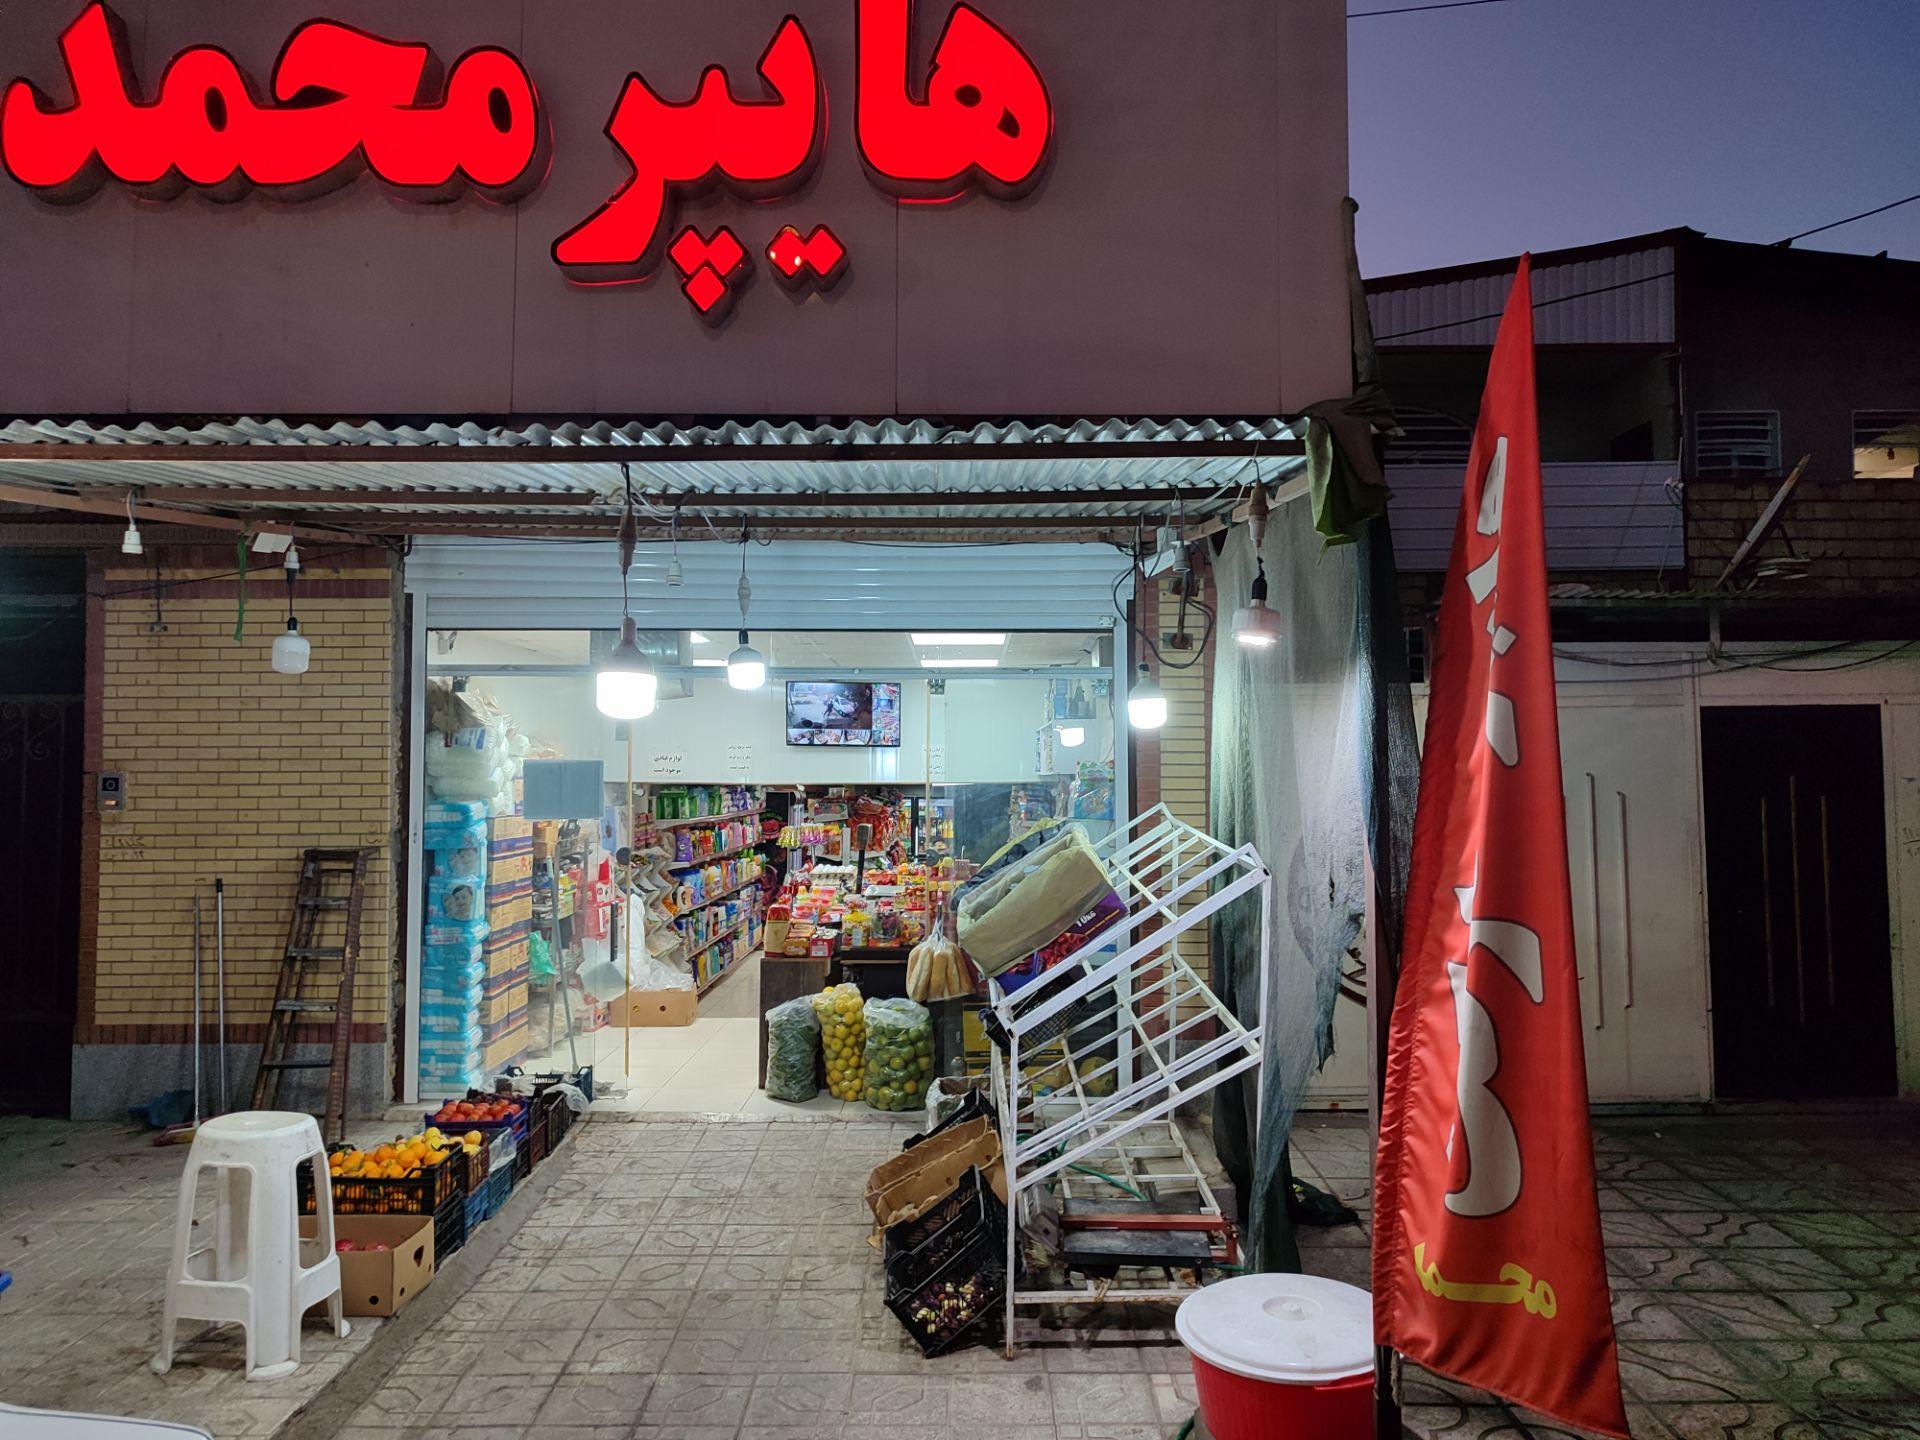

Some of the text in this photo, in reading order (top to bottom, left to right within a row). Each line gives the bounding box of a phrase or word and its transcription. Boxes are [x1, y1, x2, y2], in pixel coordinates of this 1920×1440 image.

[2, 0, 1053, 315] هایپر محمد
[1413, 1241, 1558, 1320] محمد
